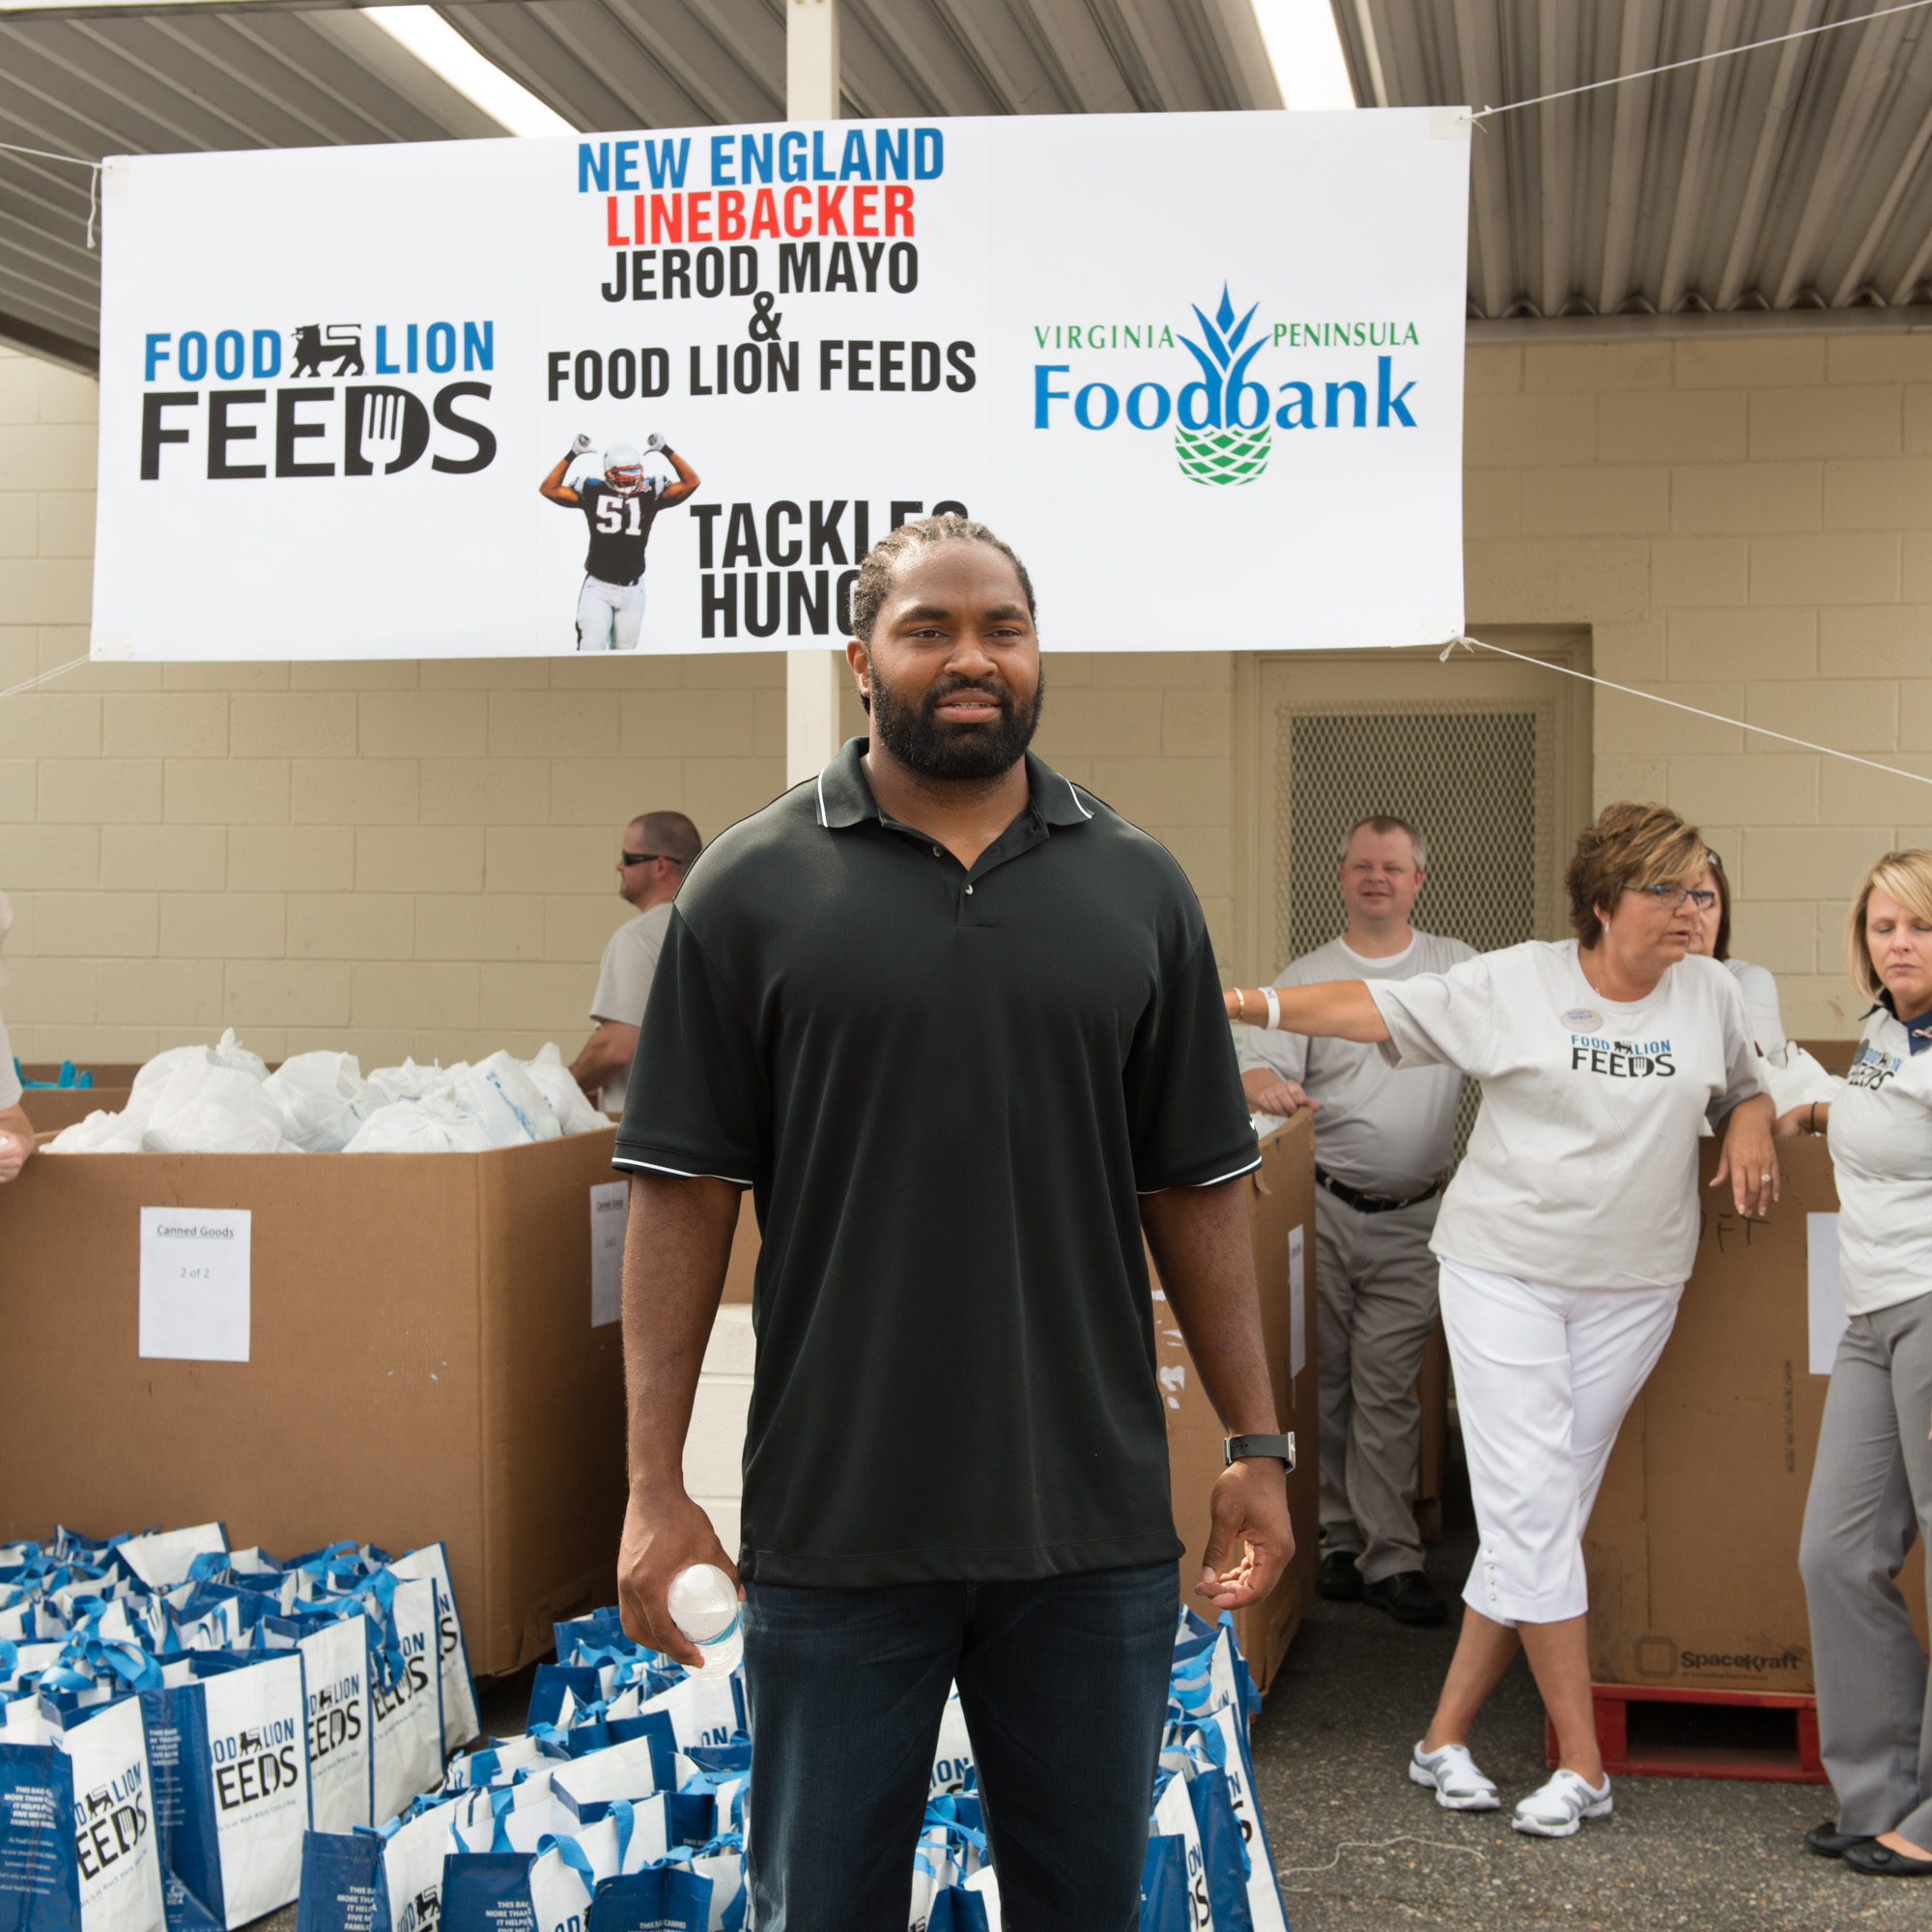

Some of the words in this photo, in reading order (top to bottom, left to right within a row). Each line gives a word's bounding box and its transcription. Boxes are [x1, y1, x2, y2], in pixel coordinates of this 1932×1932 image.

[578, 137, 691, 193] NEW
[711, 127, 945, 185] ENGLAND
[607, 185, 915, 246] LINEBACKER
[601, 245, 759, 302] JEROD
[779, 242, 919, 294] MAYO
[749, 291, 782, 342] &
[1034, 324, 1176, 349] VIRGINIA
[1273, 322, 1420, 347] PENINSULA
[144, 329, 282, 382] FOOD
[375, 320, 495, 375] LION
[548, 348, 669, 402] FOOD
[690, 341, 800, 396] LION
[819, 340, 977, 393] FEEDS
[1034, 355, 1419, 431] Foodbank
[139, 381, 497, 481] FEEDS
[596, 494, 641, 536] 51
[690, 499, 969, 569] TACKL
[1571, 1035, 1610, 1050] FOOD
[1634, 1038, 1671, 1055] LION
[1572, 1047, 1676, 1077] FEEDS
[157, 1225, 197, 1237] Canned
[200, 1226, 234, 1238] Goods
[181, 1267, 186, 1277] 2
[189, 1267, 200, 1278] of
[204, 1268, 210, 1278] 2
[1681, 1651, 1799, 1672] SpaceKraft
[333, 1673, 360, 1704] LION
[263, 1718, 295, 1748] LION
[111, 1761, 142, 1803] LION
[336, 1894, 358, 1903] MORE
